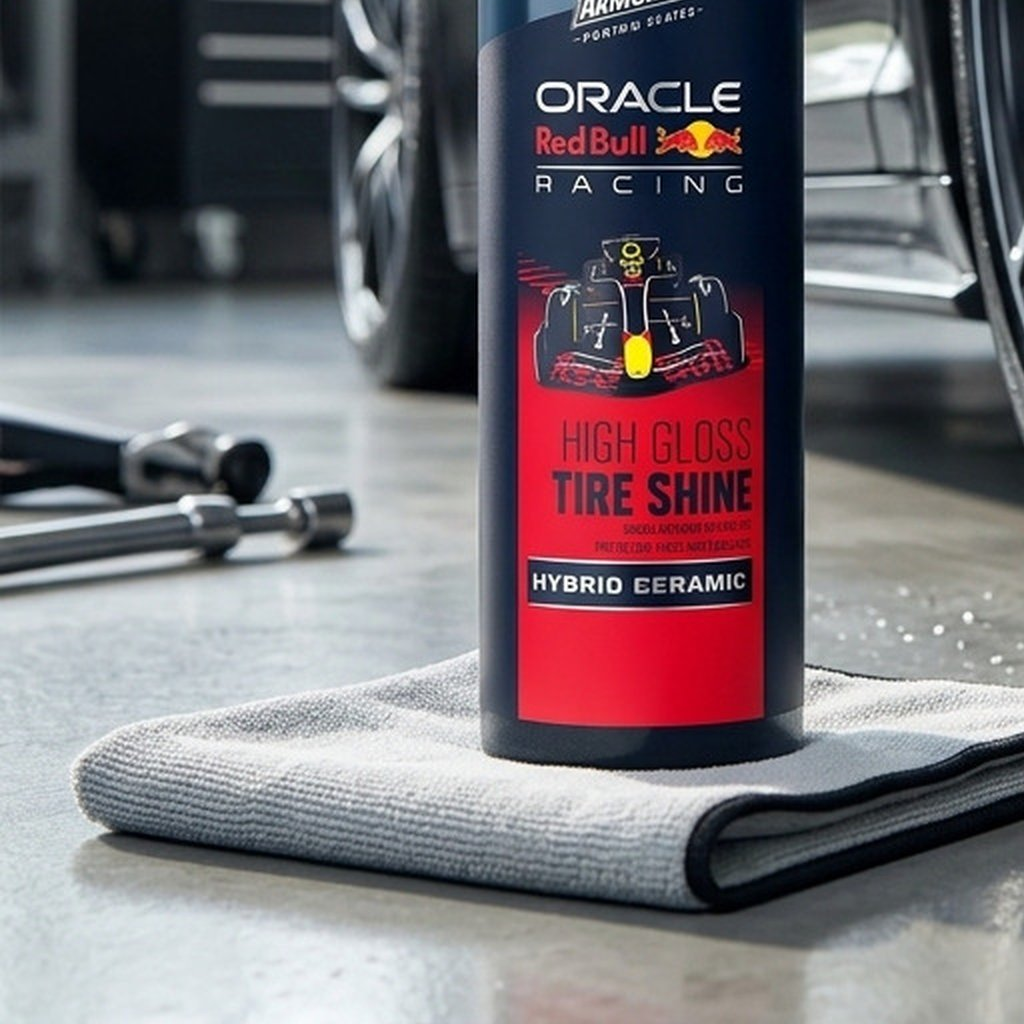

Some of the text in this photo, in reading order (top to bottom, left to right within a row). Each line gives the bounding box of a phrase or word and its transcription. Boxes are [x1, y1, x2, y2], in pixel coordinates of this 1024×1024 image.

[535, 81, 742, 114] ORACLE
[535, 175, 744, 194] RACING
[562, 417, 752, 465] HIGH GLOSS
[552, 467, 753, 517] TIRE SHINE
